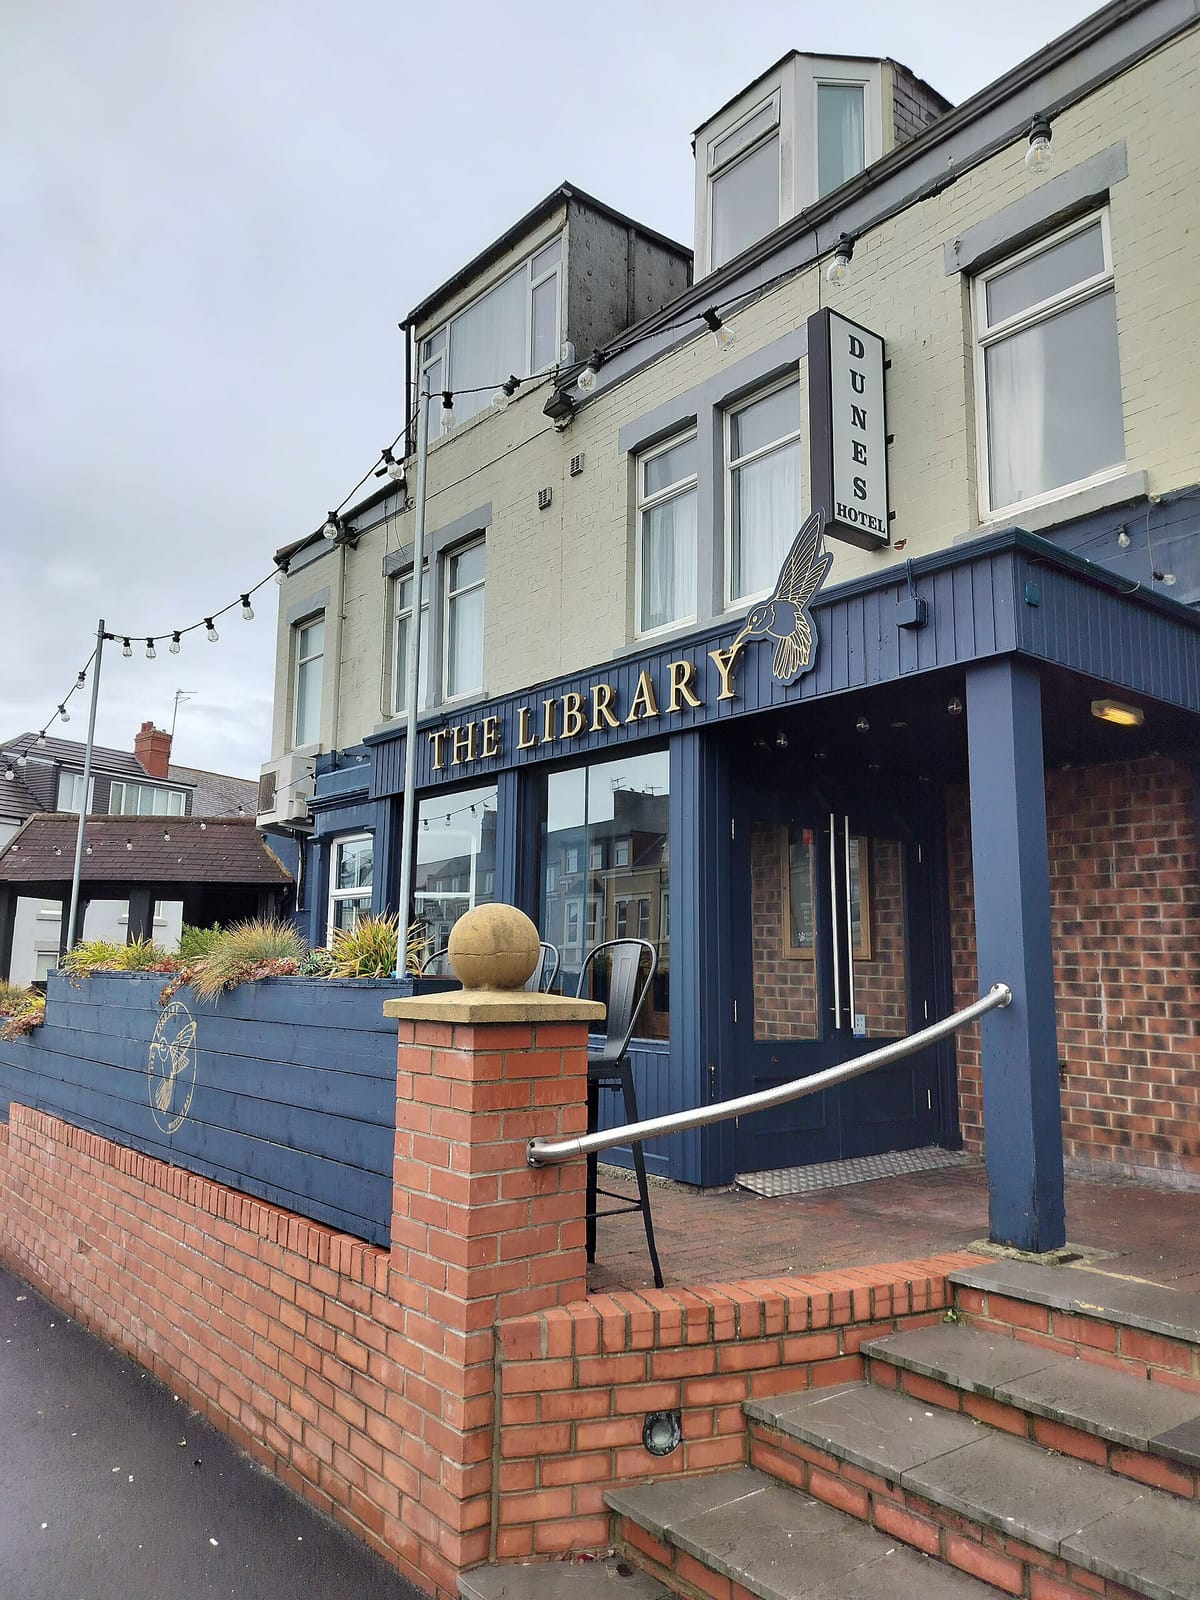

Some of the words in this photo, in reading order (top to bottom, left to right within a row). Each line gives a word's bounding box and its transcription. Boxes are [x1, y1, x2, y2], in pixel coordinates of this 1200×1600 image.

[848, 334, 868, 501] DUNES
[836, 502, 886, 533] HOTEL
[428, 715, 502, 770] THE
[516, 643, 745, 750] LIBRARY
